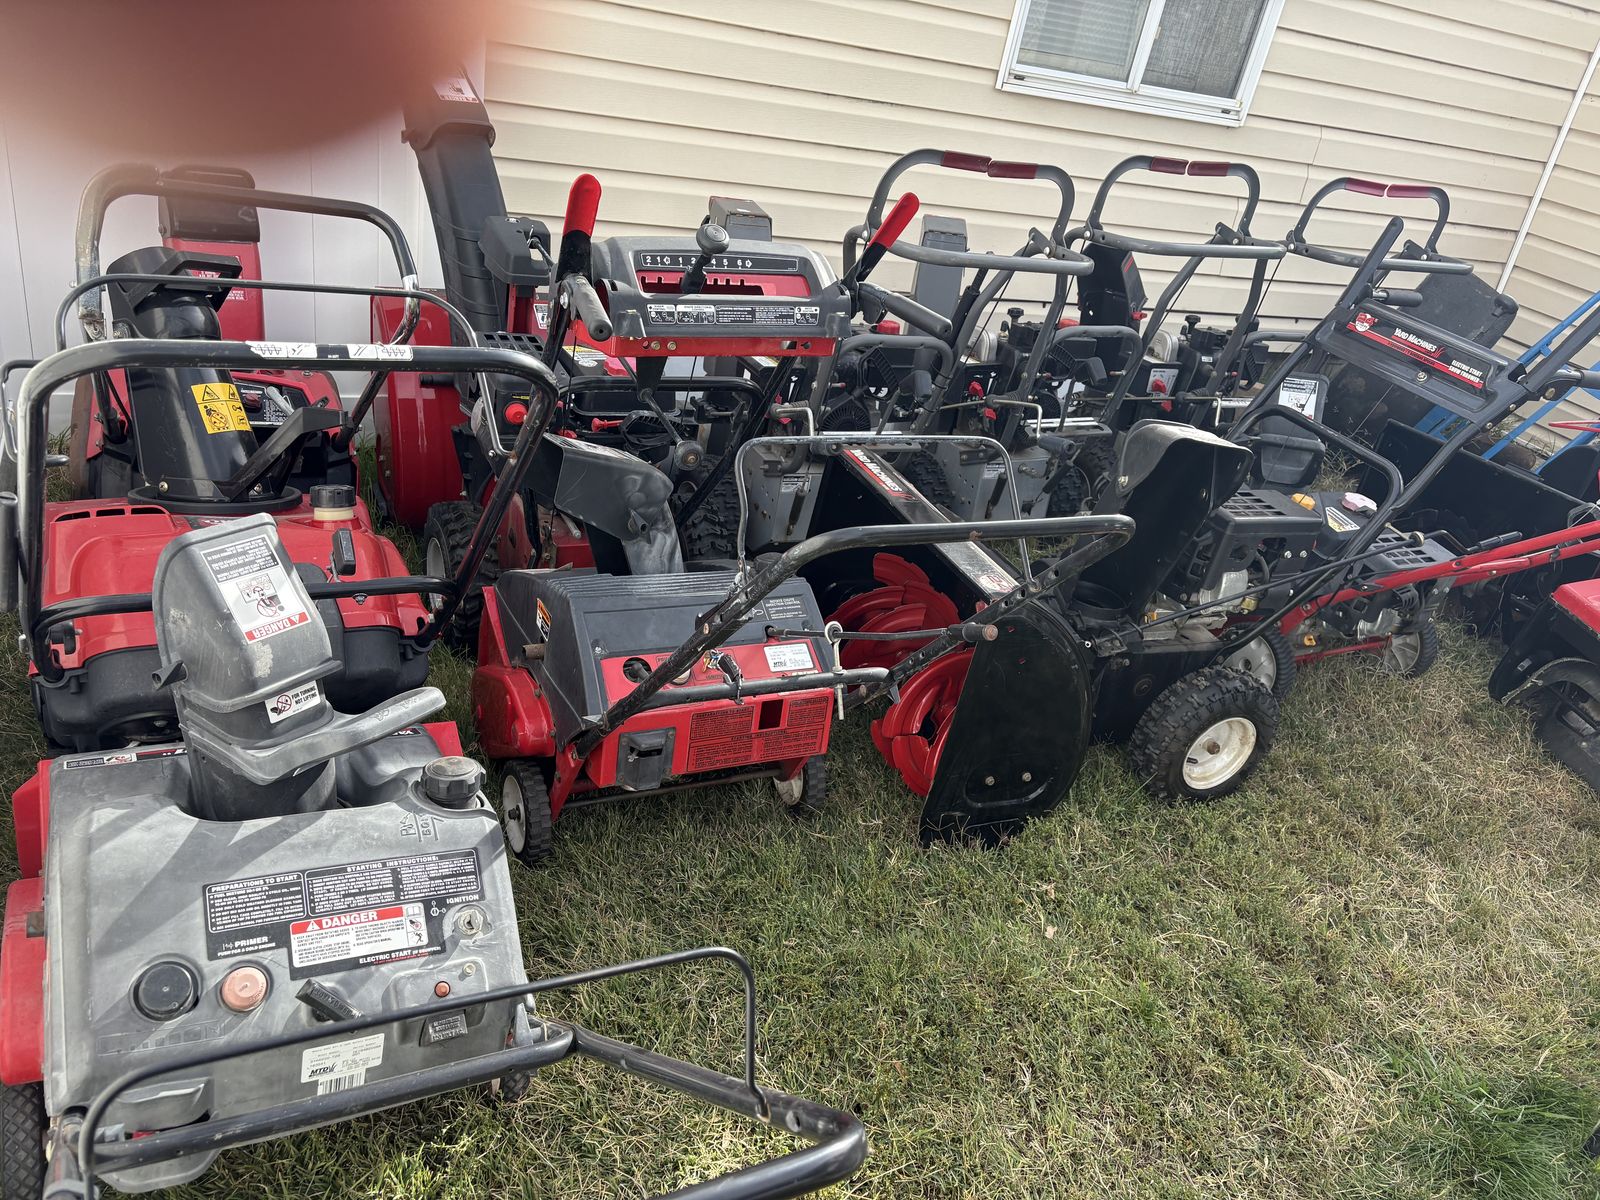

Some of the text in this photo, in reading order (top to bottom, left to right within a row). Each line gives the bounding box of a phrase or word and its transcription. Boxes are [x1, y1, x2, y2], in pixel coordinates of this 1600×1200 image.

[645, 255, 652, 263] 2
[656, 255, 661, 263] 1
[678, 256, 683, 264] 1
[723, 258, 728, 266] 5
[1394, 327, 1437, 352] YARD MACHINES
[1469, 367, 1483, 377] START
[863, 462, 903, 491] MACHINES
[252, 618, 291, 638] DANGER
[299, 685, 316, 697] TURNING
[303, 691, 317, 702] LIFTING
[346, 855, 439, 873] STARTING INSTRUCTIONS:
[211, 874, 298, 893] PREPARATIONS TO START
[446, 894, 479, 904] IGNITION
[321, 910, 378, 929] DANGER
[234, 936, 269, 948] PRIMER
[359, 953, 391, 964] ELECTRIC
[391, 949, 411, 958] START
[310, 1066, 329, 1076] MTD
